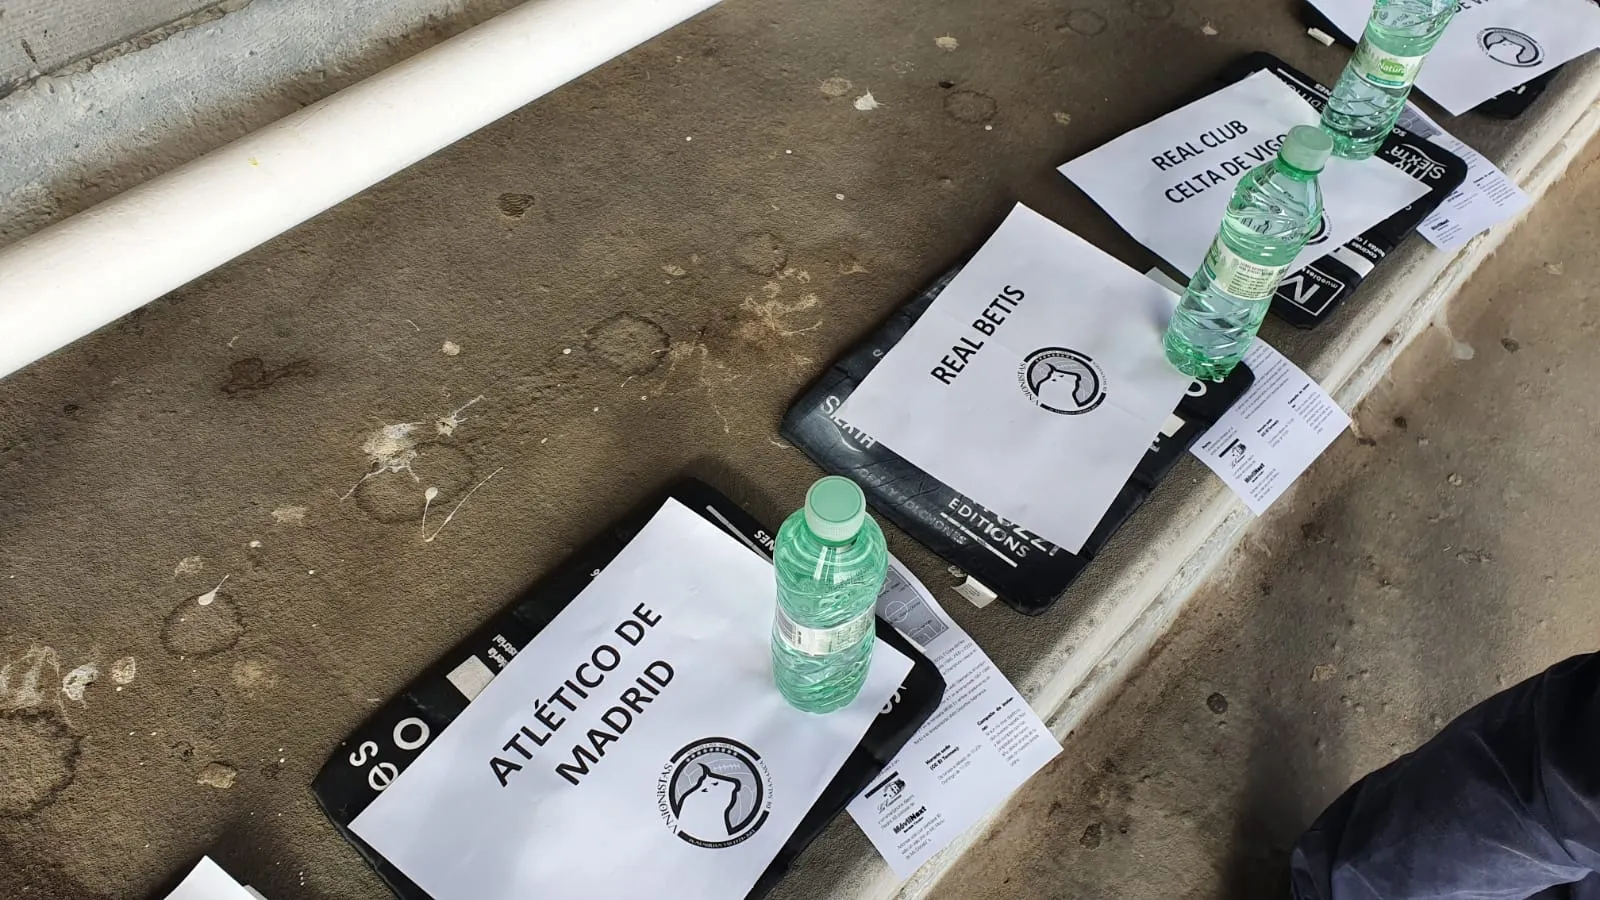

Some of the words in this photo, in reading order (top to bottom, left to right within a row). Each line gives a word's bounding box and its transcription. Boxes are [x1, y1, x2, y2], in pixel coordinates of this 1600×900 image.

[1151, 141, 1205, 172] REAL
[1199, 119, 1249, 148] CLUB
[1164, 169, 1228, 204] CELTA
[1219, 155, 1252, 177] DE
[930, 336, 985, 385] REAL
[971, 284, 1025, 337] BETIS
[947, 497, 1031, 558] EDITIONS
[489, 644, 621, 788] ATLÉTICO
[614, 602, 662, 647] DE
[555, 660, 675, 786] MADRID
[892, 805, 927, 835] MóvilNext
